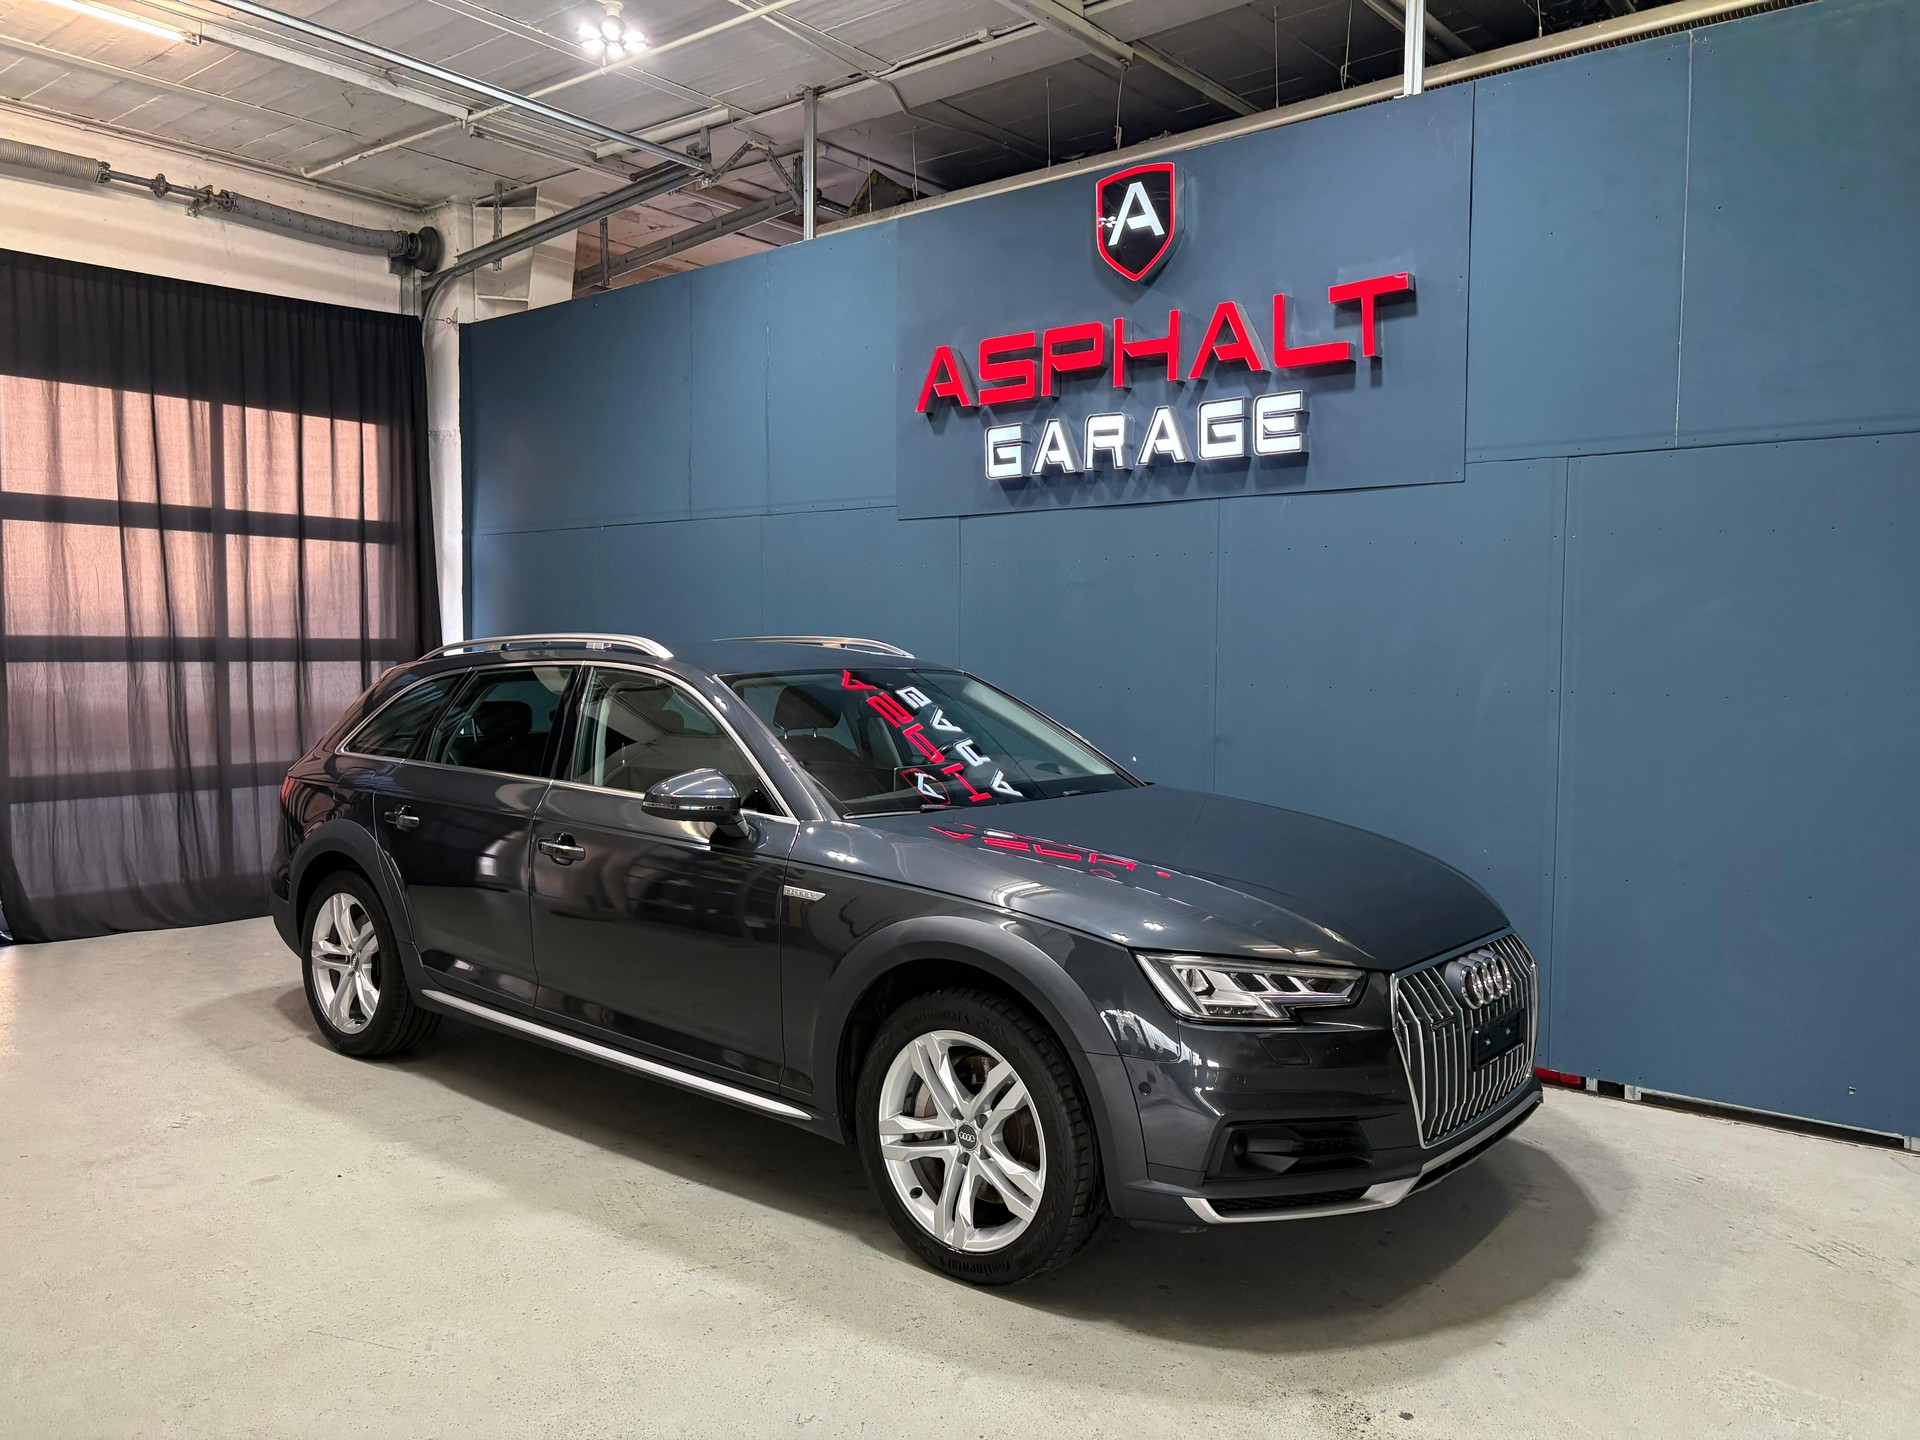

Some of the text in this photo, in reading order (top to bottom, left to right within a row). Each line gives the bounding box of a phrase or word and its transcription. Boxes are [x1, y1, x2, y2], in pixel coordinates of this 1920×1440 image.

[1108, 181, 1165, 247] A
[916, 272, 1413, 413] ASPHALT
[985, 390, 1307, 480] GARAGE
